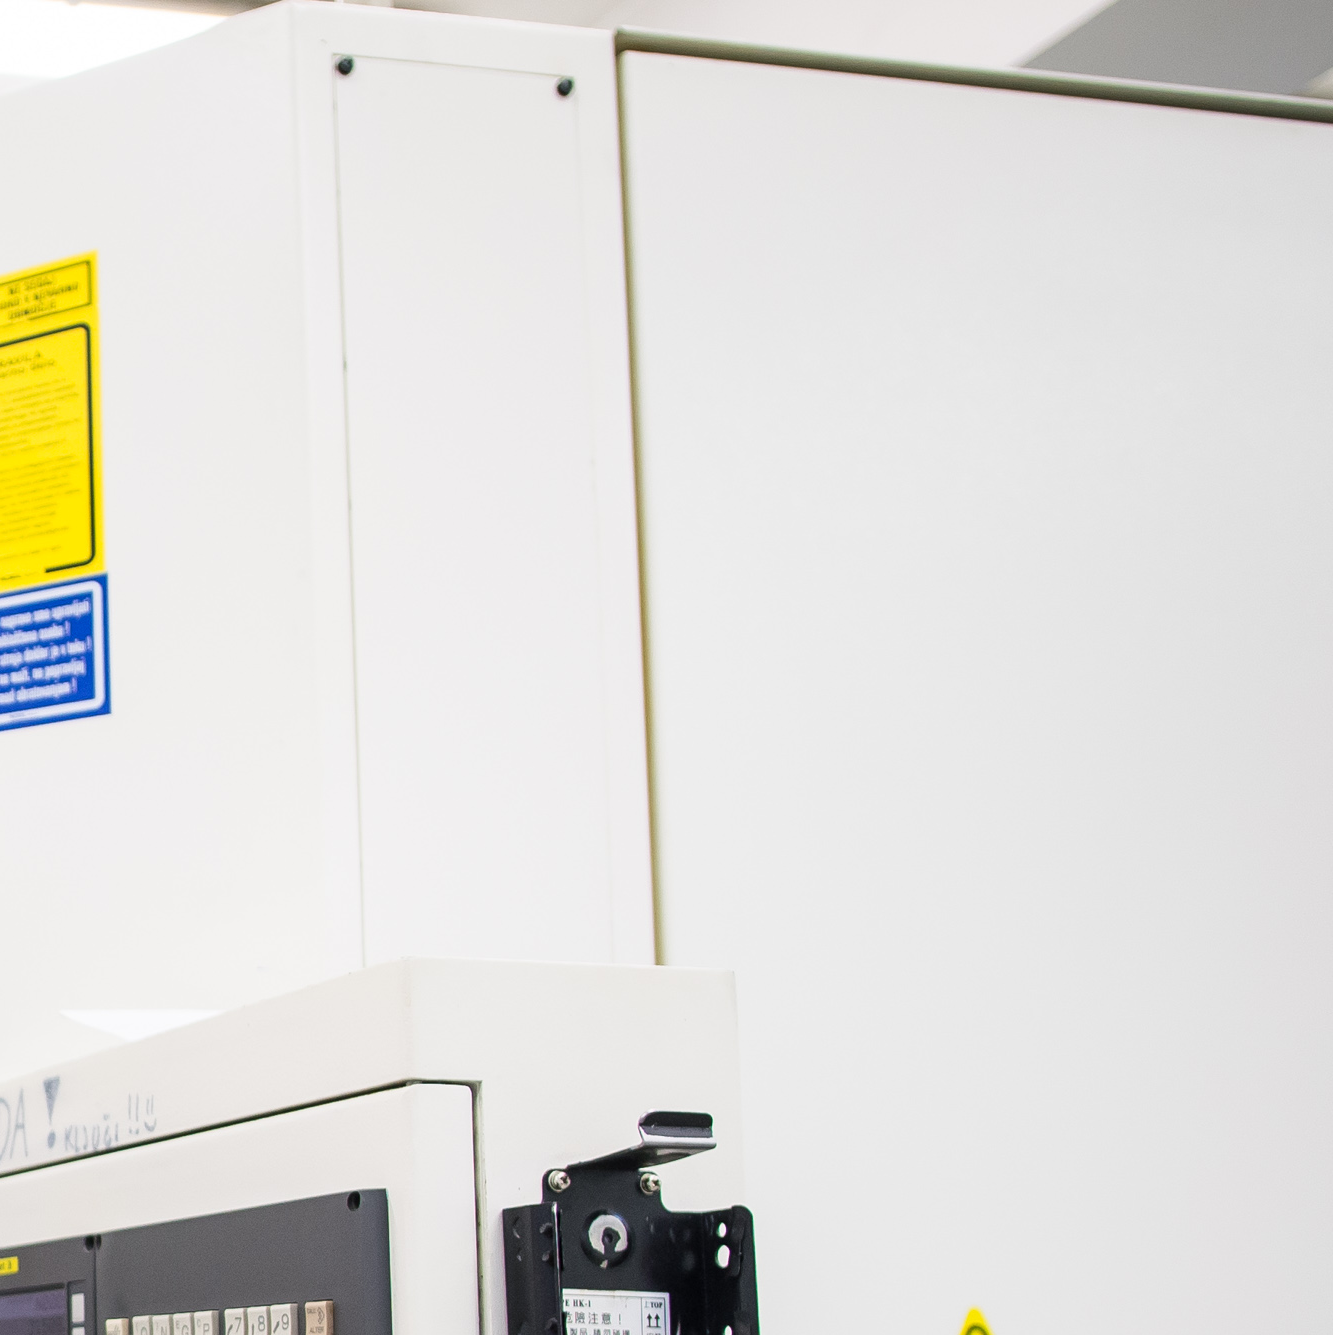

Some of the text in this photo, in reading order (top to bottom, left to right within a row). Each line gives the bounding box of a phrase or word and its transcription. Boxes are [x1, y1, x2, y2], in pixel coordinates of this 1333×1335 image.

[573, 1300, 592, 1308] HK-1
[234, 1317, 242, 1332] 7
[258, 1315, 266, 1332] 8
[282, 1314, 289, 1330] 9
[309, 1326, 324, 1334] ALTER
